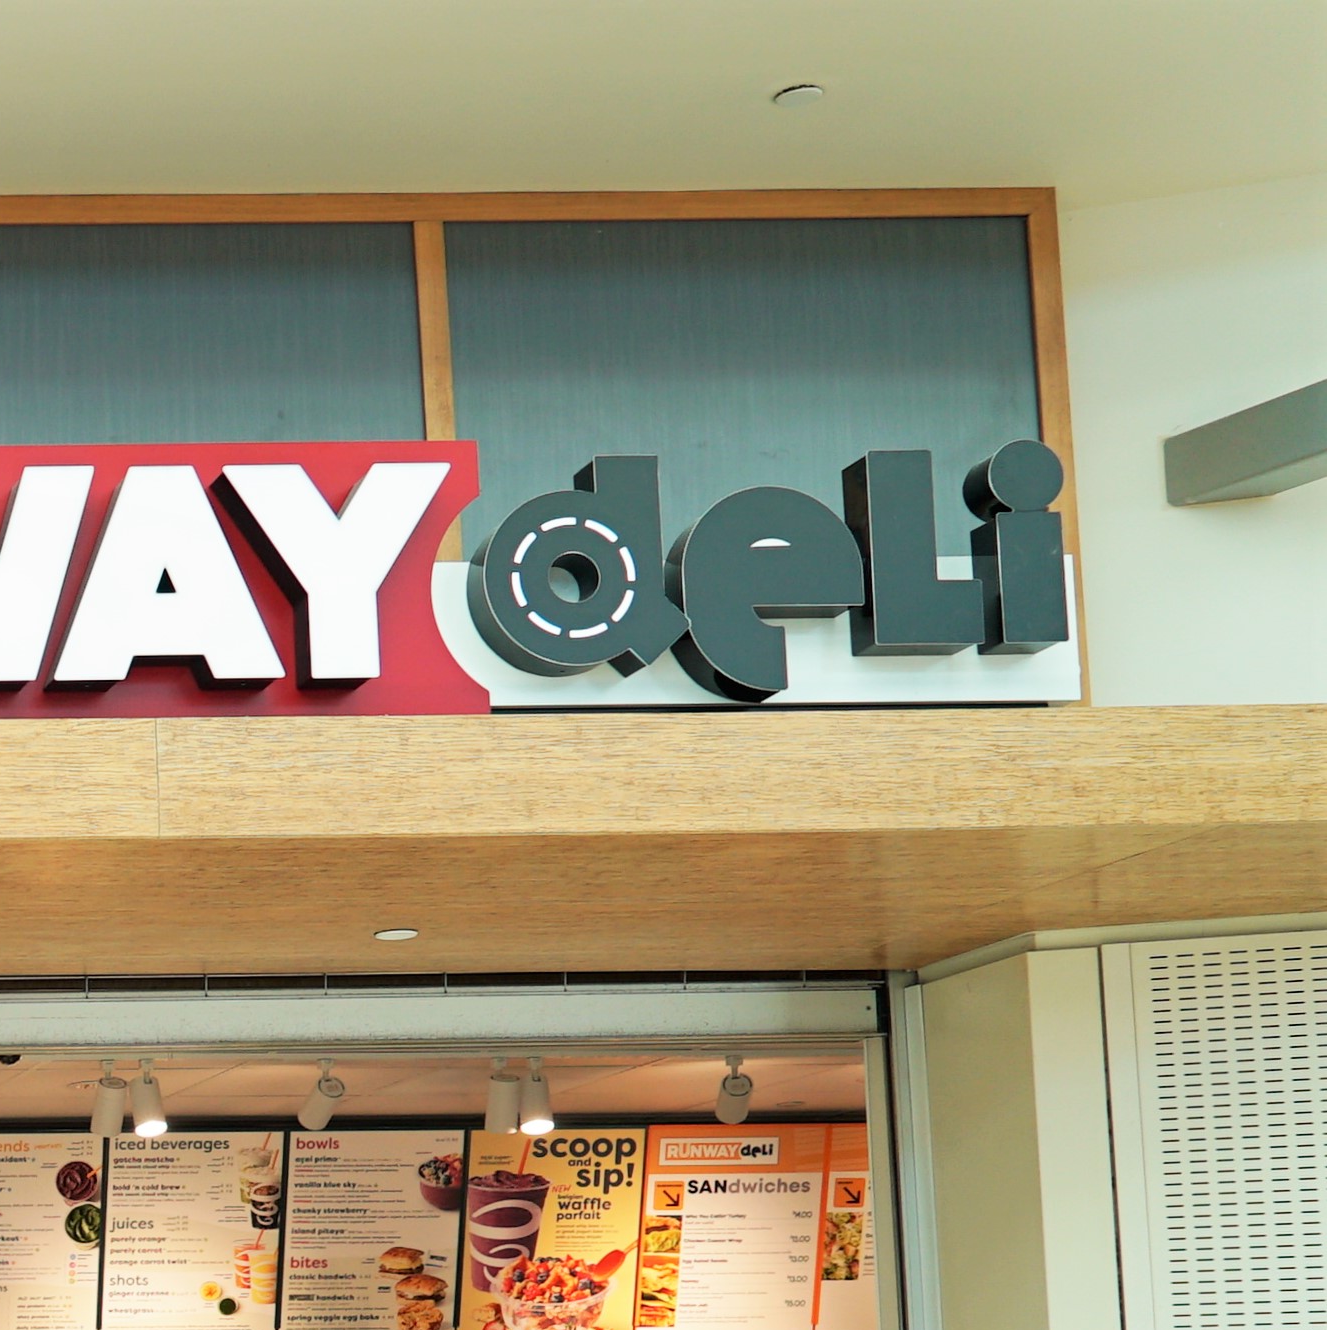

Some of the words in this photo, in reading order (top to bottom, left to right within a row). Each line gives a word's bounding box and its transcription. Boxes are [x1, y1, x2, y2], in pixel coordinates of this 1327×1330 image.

[115, 1138, 146, 1150] iced
[151, 1138, 230, 1152] beverages
[297, 1137, 340, 1149] bowls
[532, 1138, 637, 1165] scoop
[666, 1143, 740, 1159] RUNWAY
[568, 1158, 591, 1167] and
[576, 1162, 635, 1194] sip!
[552, 1185, 572, 1193] NEW
[687, 1178, 811, 1194] SANdwiches
[558, 1198, 612, 1210] waffle
[556, 1211, 601, 1223] parfait
[110, 1217, 154, 1232] juices
[290, 1256, 328, 1269] bites
[109, 1275, 149, 1286] shots
